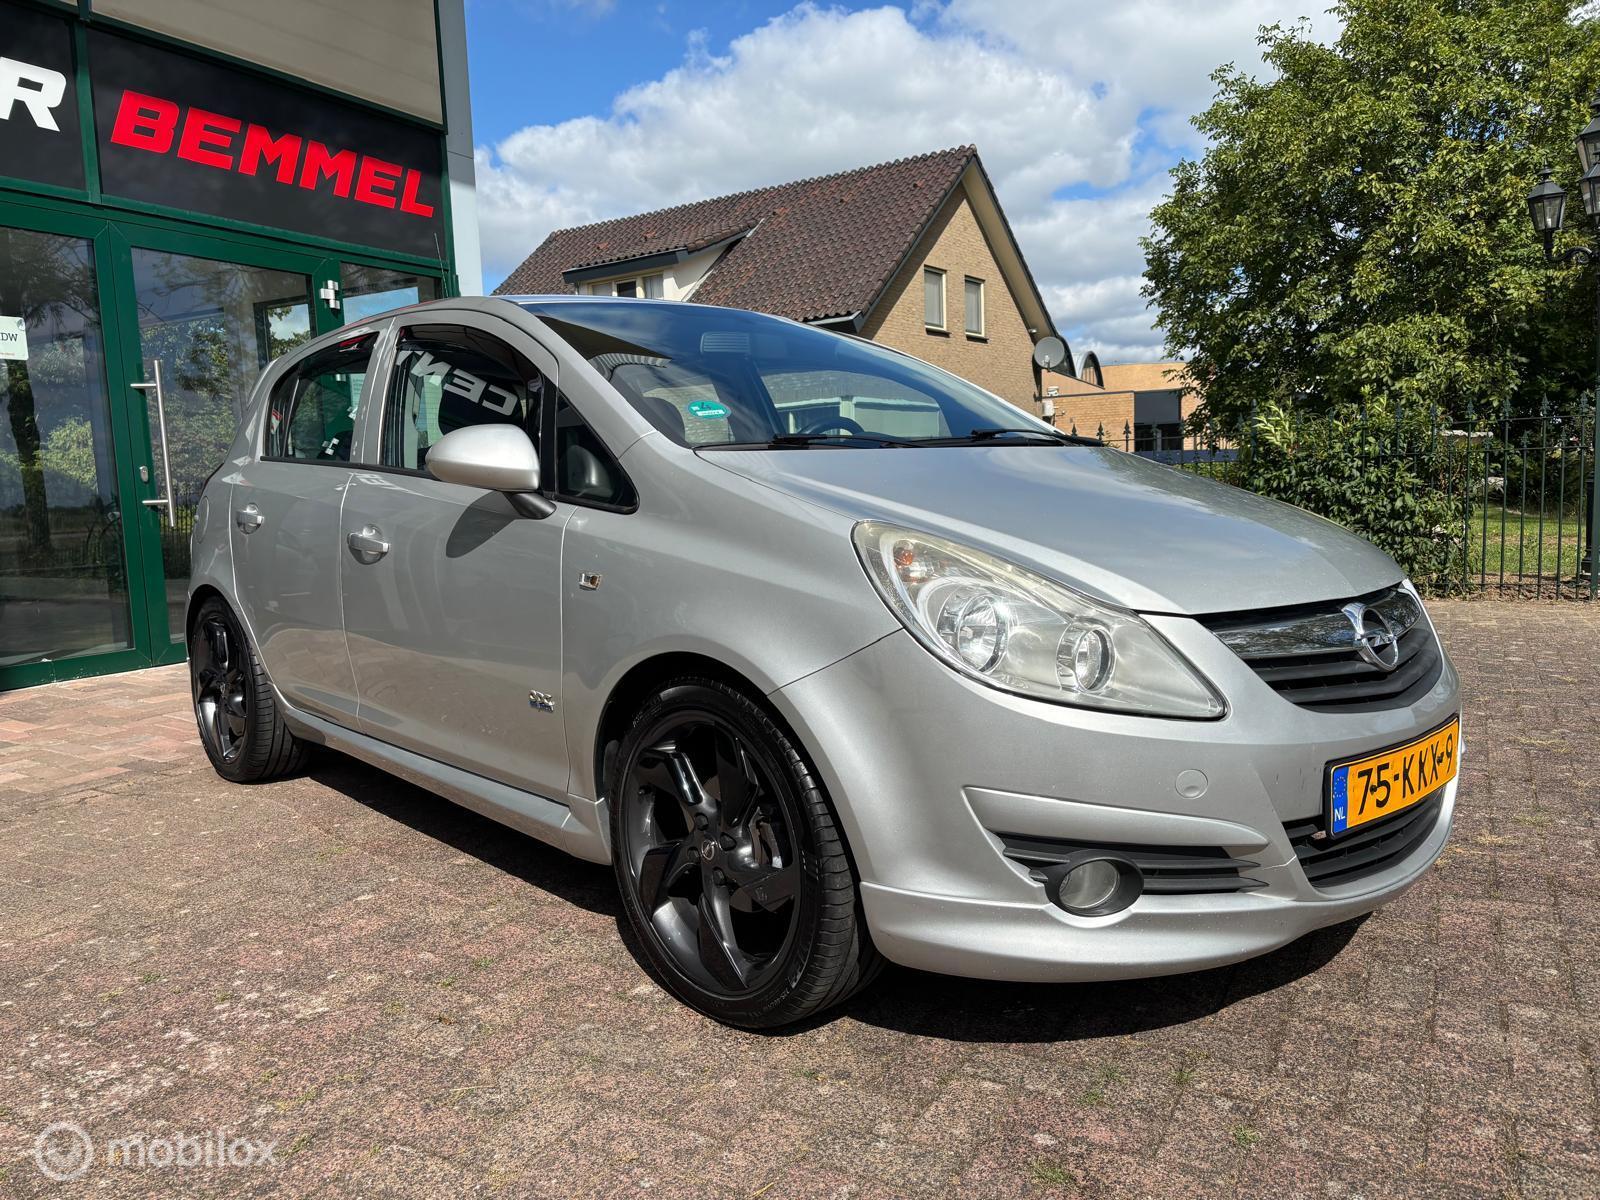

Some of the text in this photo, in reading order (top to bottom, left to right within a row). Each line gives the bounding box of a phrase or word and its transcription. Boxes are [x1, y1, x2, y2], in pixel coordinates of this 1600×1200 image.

[0, 56, 66, 131] R
[111, 90, 433, 217] BEMMEL
[1357, 733, 1453, 817] 75-KKX-9
[1334, 808, 1346, 822] NL
